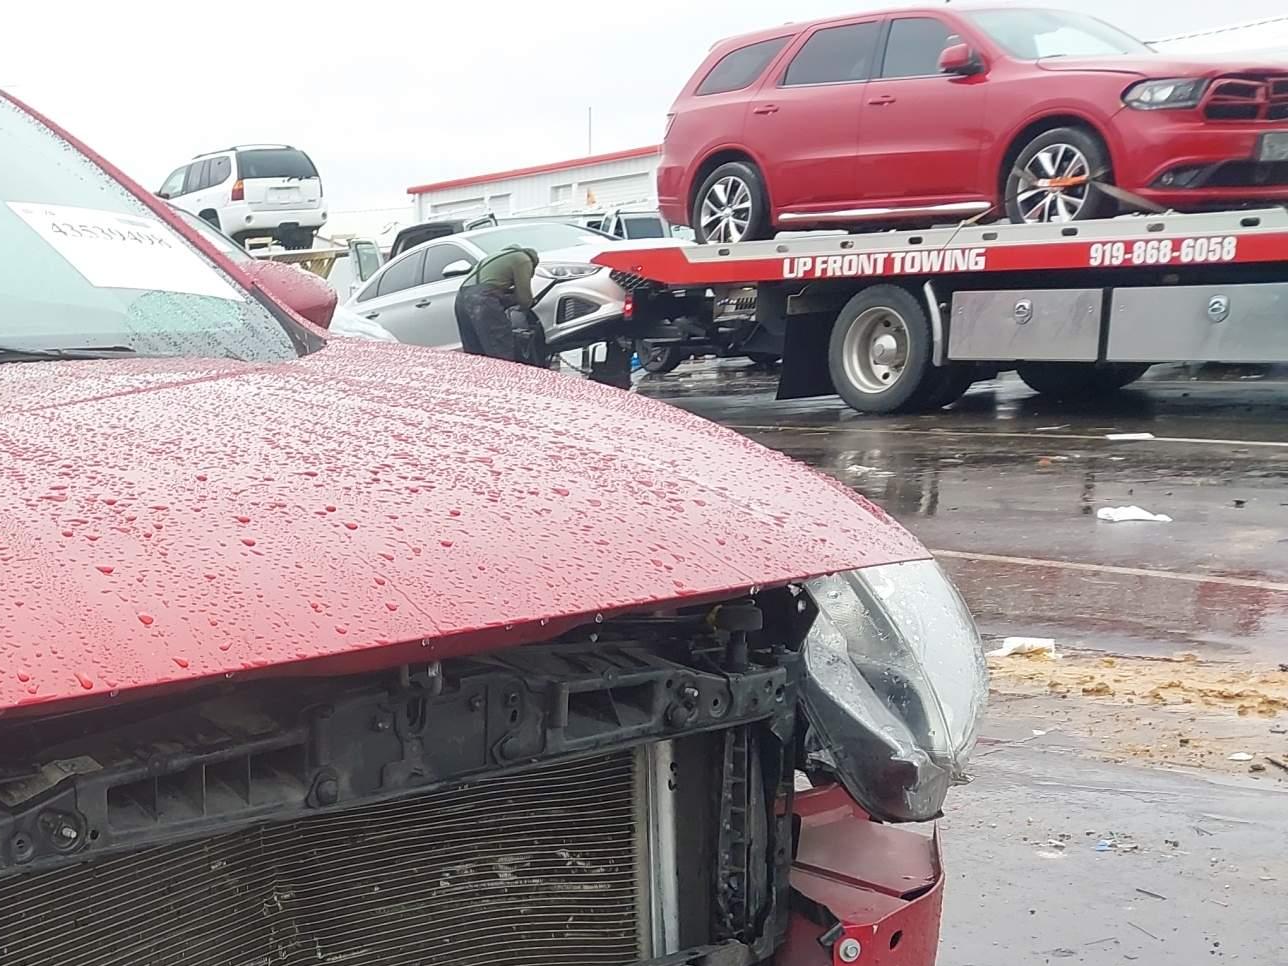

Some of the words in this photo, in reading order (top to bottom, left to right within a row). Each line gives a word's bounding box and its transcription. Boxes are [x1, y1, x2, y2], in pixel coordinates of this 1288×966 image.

[783, 256, 813, 279] UP
[814, 252, 889, 278] FRONT
[890, 247, 987, 274] TOWING
[1088, 236, 1238, 268] 919-868-6058
